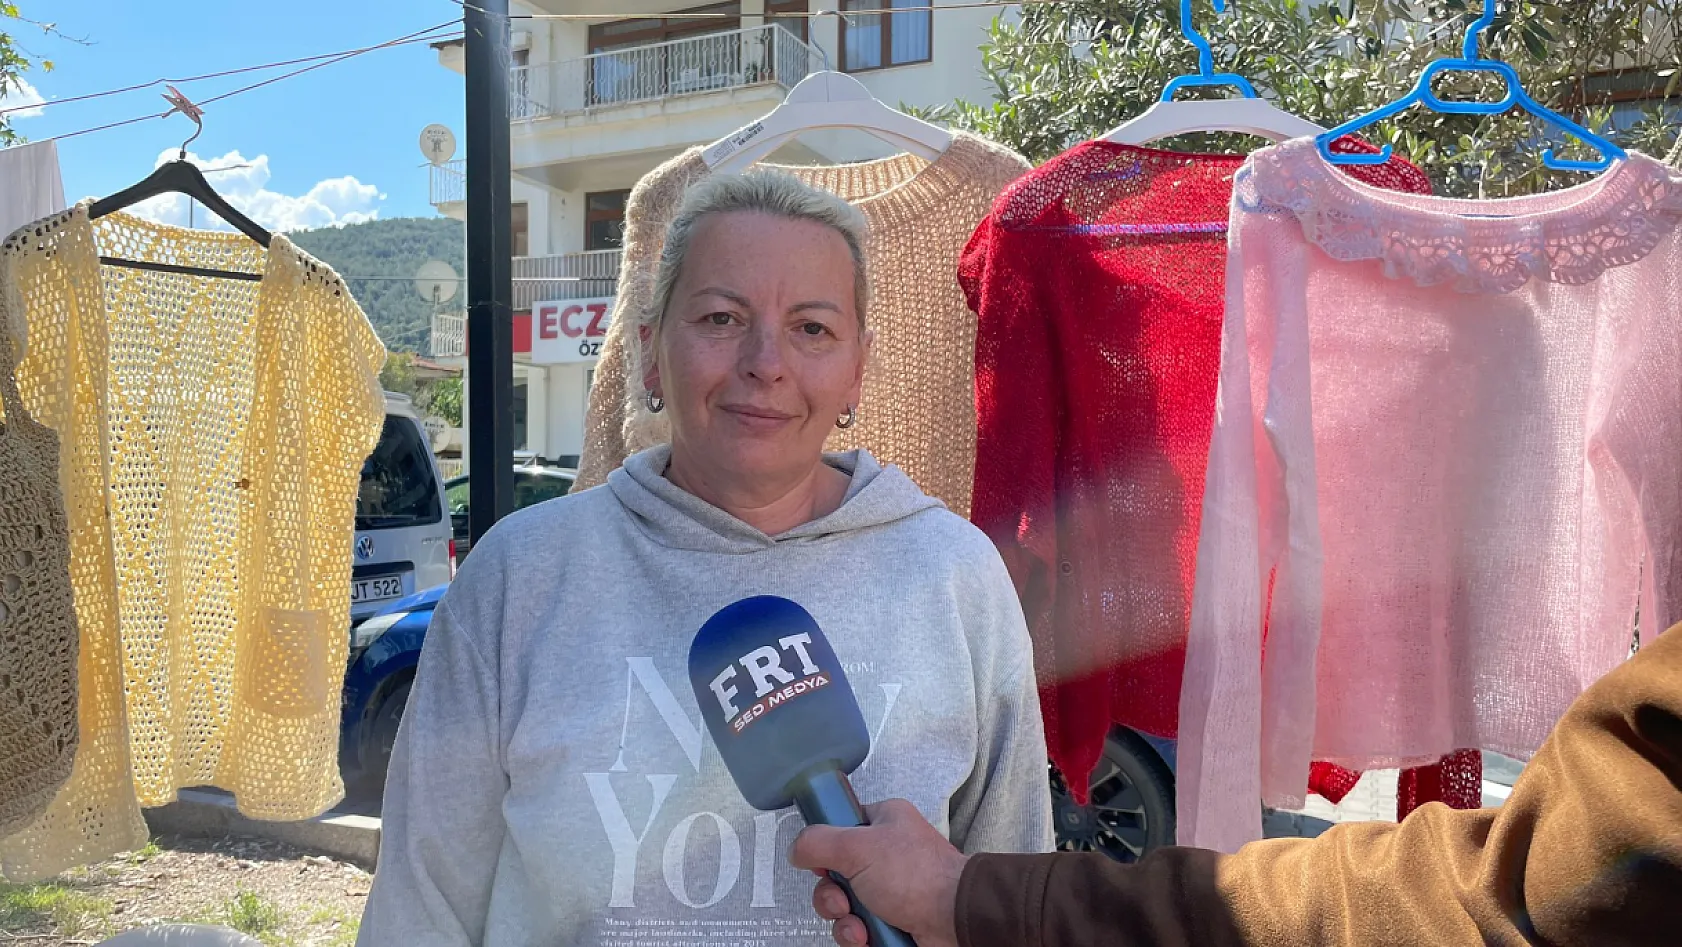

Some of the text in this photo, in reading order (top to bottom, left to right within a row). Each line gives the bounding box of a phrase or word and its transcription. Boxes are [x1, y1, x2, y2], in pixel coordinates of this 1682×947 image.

[579, 340, 603, 356] ÖZ
[373, 579, 400, 597] 522
[840, 661, 874, 673] ROM
[709, 631, 820, 724] FRT
[734, 675, 830, 732] SED MEDYA
[583, 773, 806, 909] Yor
[605, 918, 631, 928] Many
[635, 918, 676, 926] districts
[620, 929, 648, 938] major
